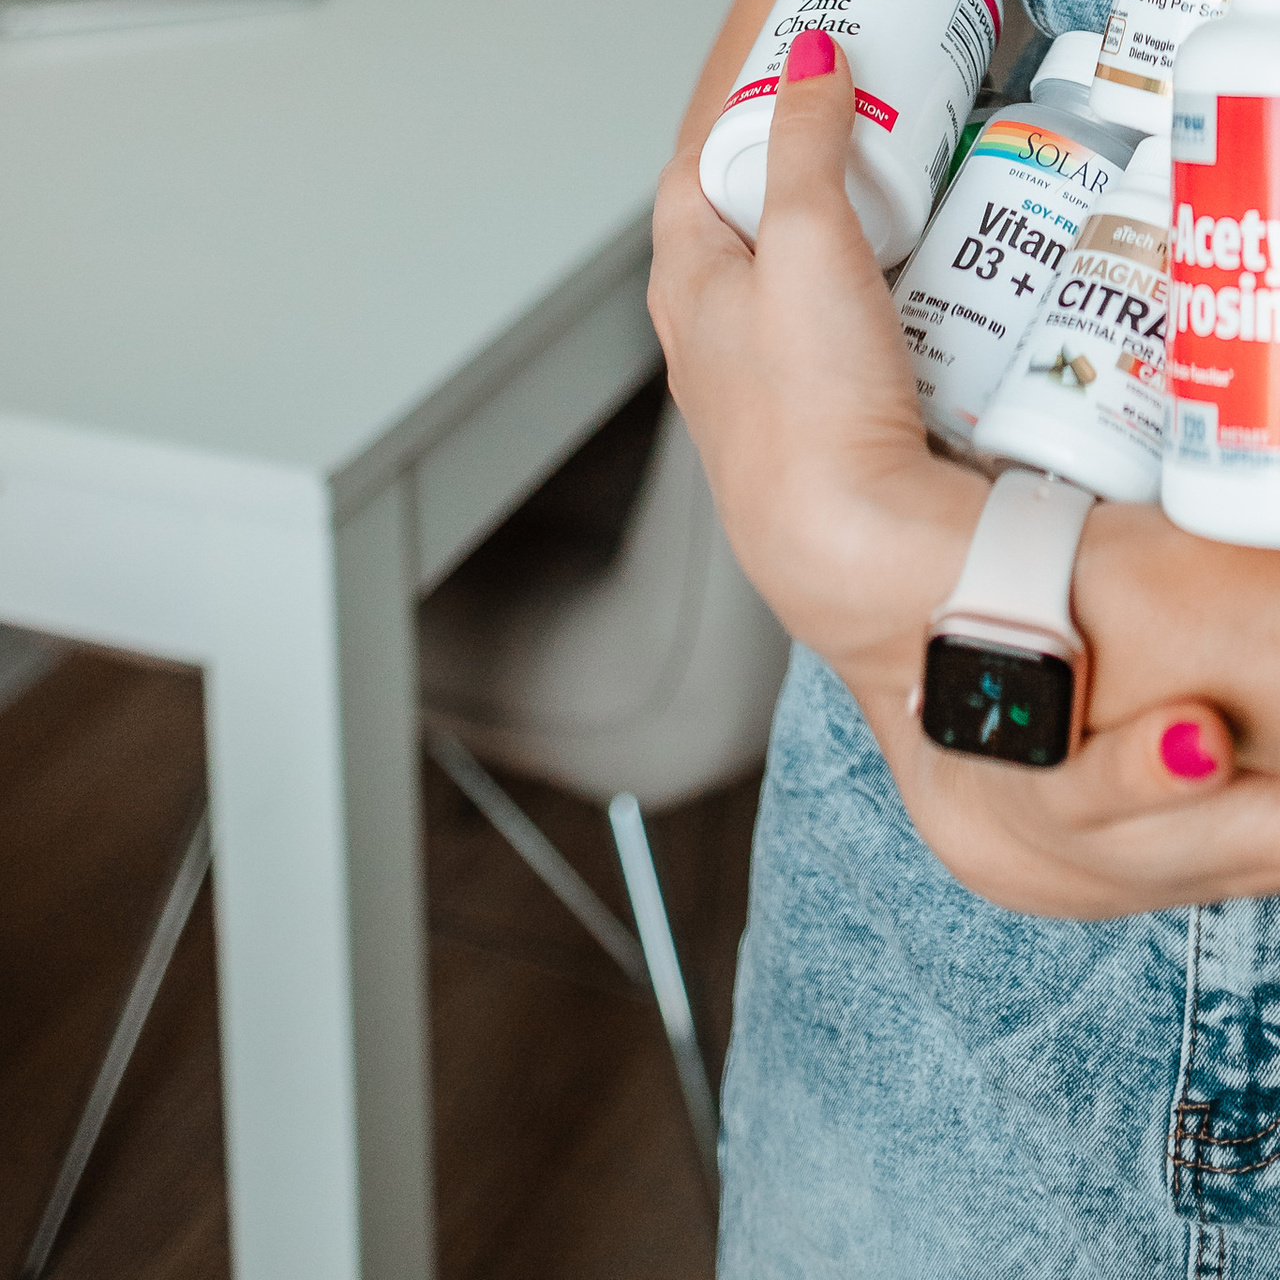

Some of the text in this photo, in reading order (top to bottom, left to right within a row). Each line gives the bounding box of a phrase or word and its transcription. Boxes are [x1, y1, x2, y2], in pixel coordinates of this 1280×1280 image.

[774, 13, 861, 37] Chelate
[1132, 32, 1175, 53] 60 Veggie
[765, 62, 780, 73] 90
[1128, 46, 1159, 67] Dietary
[739, 85, 762, 101] SKIN
[762, 83, 773, 93] &
[1018, 131, 1109, 194] SOLAR
[1008, 167, 1051, 190] DIETARY
[951, 236, 1035, 298] D3 +
[900, 303, 945, 326] Vitamin D3
[908, 289, 926, 302] 125
[926, 296, 950, 312] mcg
[950, 303, 988, 327] (5000
[1046, 313, 1118, 344] ESSENTIAL
[1121, 336, 1155, 362] FOR
